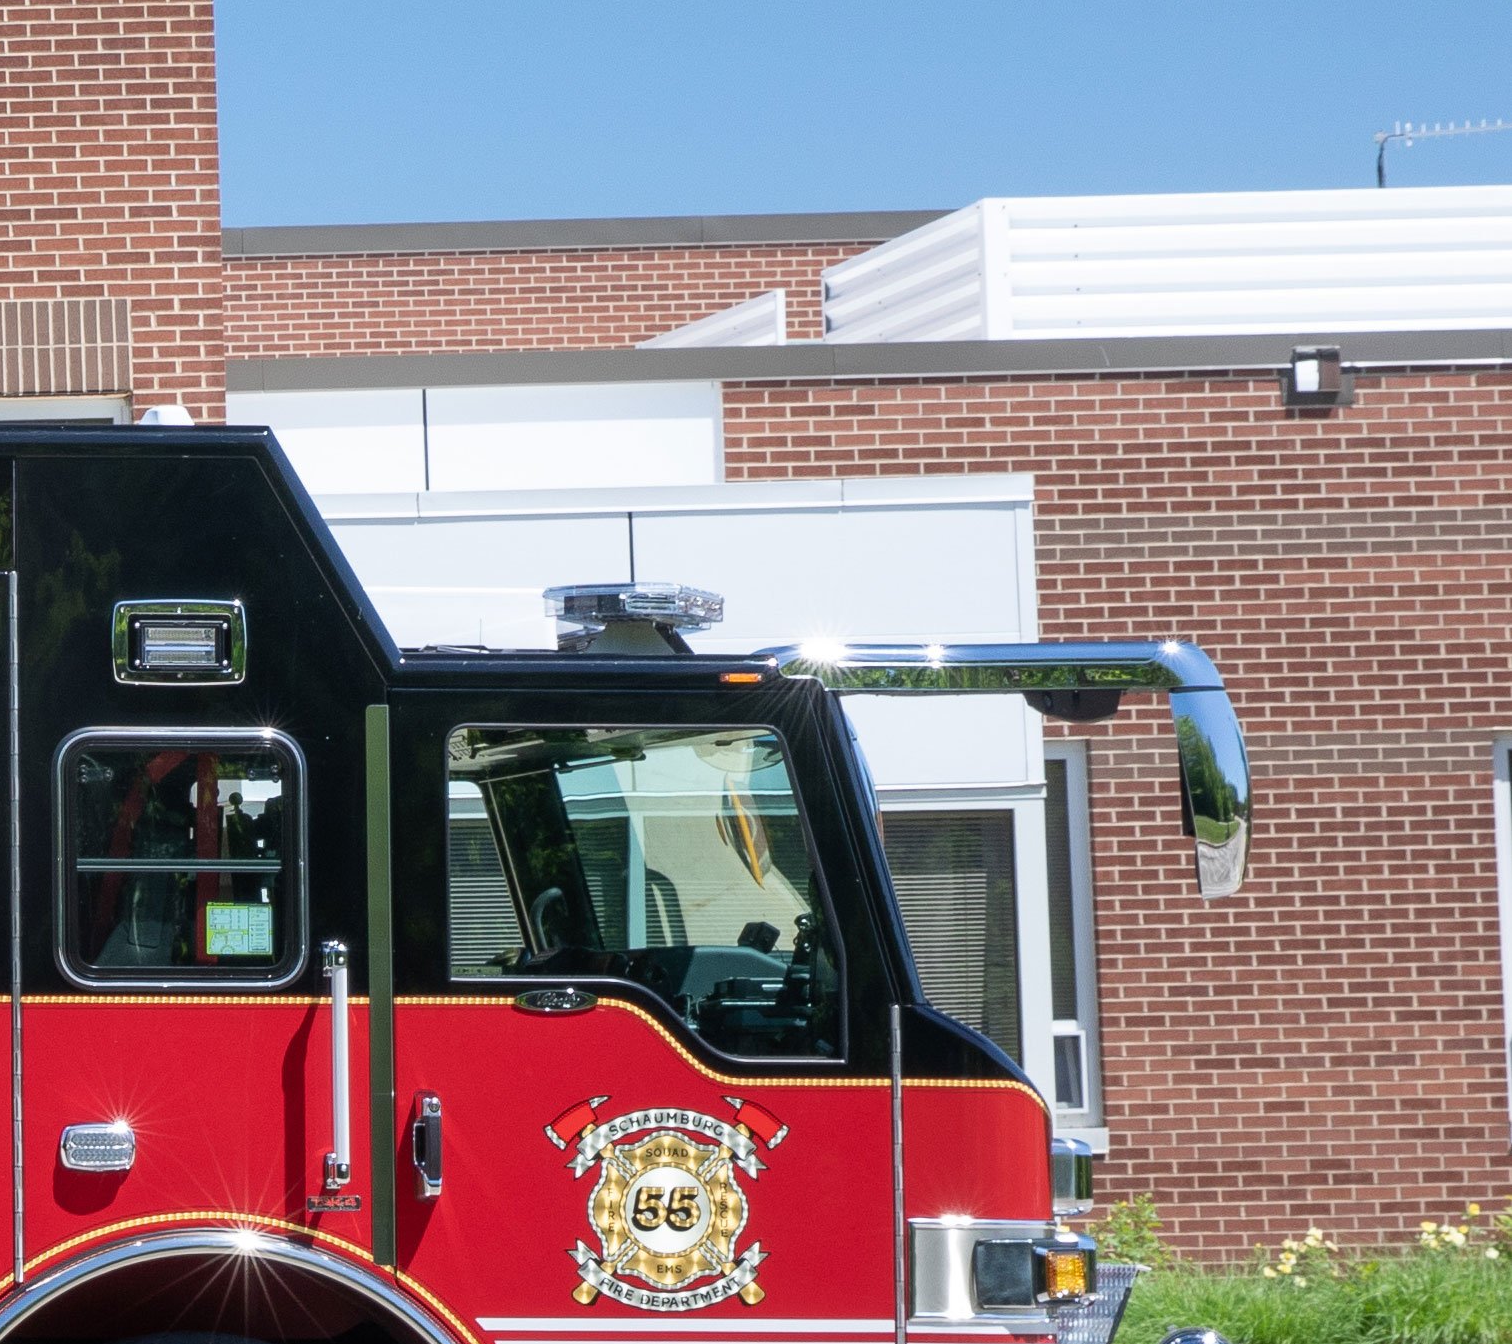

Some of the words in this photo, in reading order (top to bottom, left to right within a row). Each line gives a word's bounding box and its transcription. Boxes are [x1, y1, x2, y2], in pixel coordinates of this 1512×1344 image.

[609, 1112, 725, 1137] SCHAUMBURG
[607, 1188, 615, 1232] FIRE
[632, 1186, 701, 1232] 55
[719, 1182, 727, 1238] RESCUE
[656, 1264, 683, 1274] EMS
[600, 1277, 634, 1301] FIRE
[640, 1276, 740, 1309] DEPARTMENT
